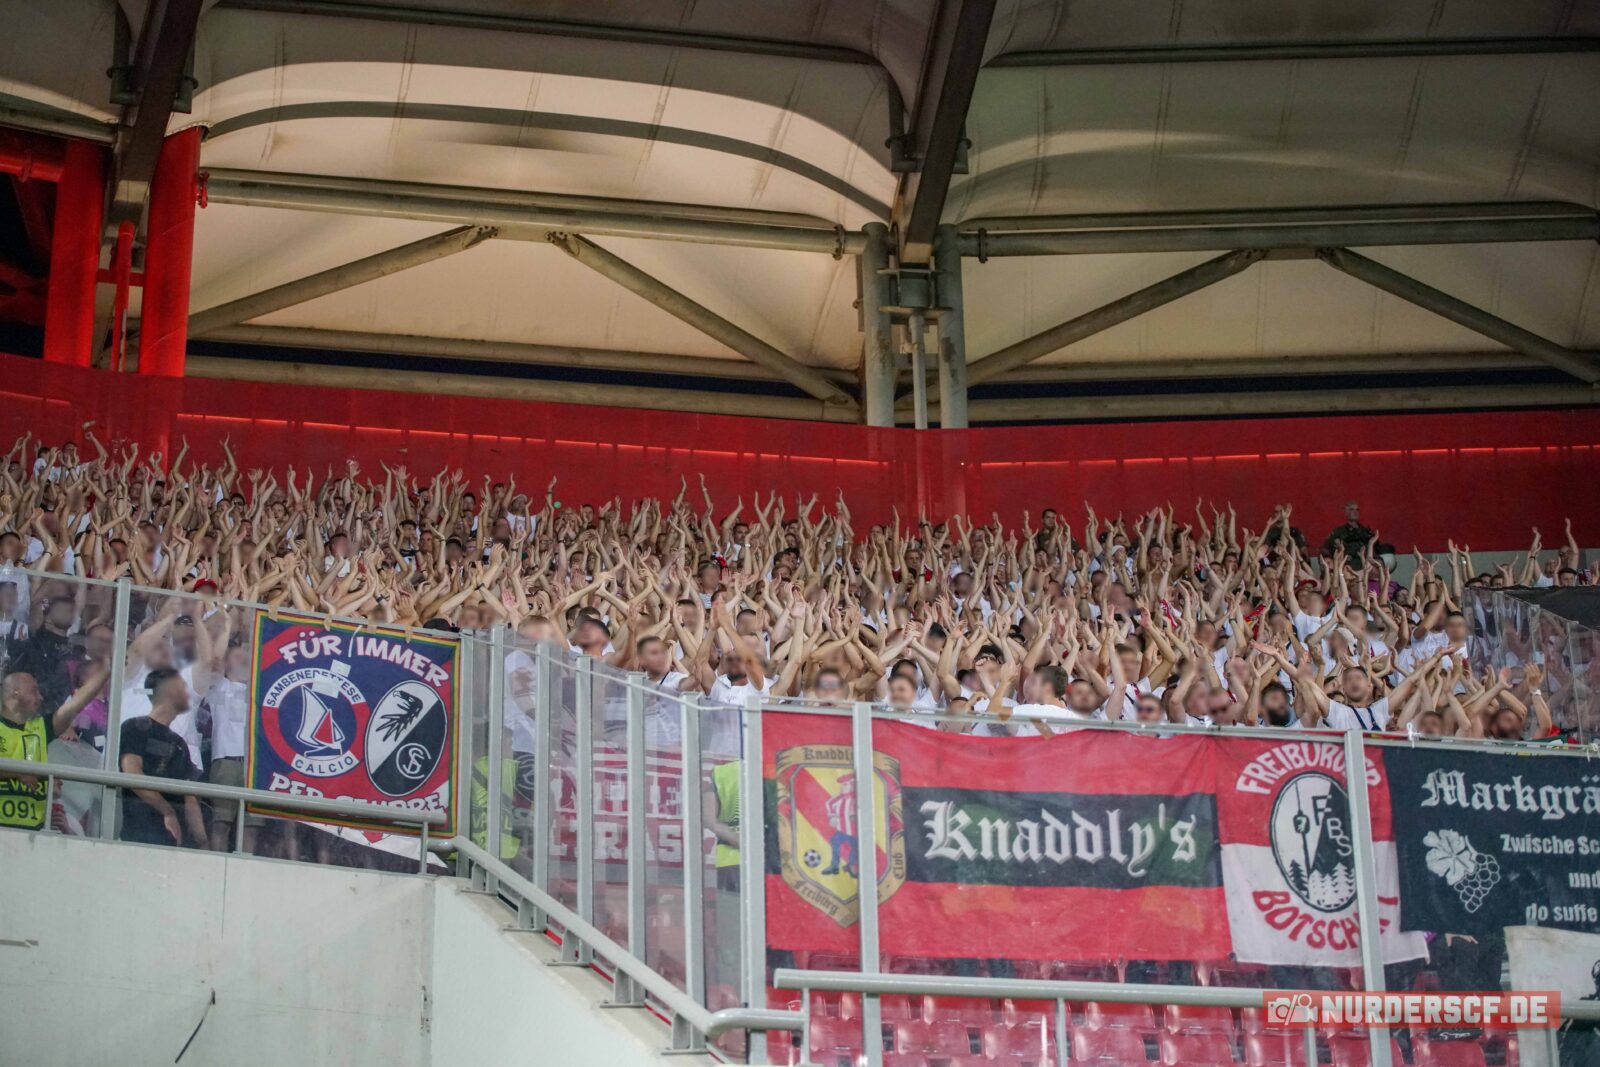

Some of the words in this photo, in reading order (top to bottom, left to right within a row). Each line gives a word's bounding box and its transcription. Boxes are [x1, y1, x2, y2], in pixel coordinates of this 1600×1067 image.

[279, 631, 343, 665] FÜR
[355, 636, 450, 688] IMMER
[295, 755, 354, 774] CALCIO
[920, 800, 1197, 878] Knaddly's
[1500, 833, 1575, 855] Zwische
[1525, 902, 1549, 922] do
[1553, 904, 1598, 923] suffe
